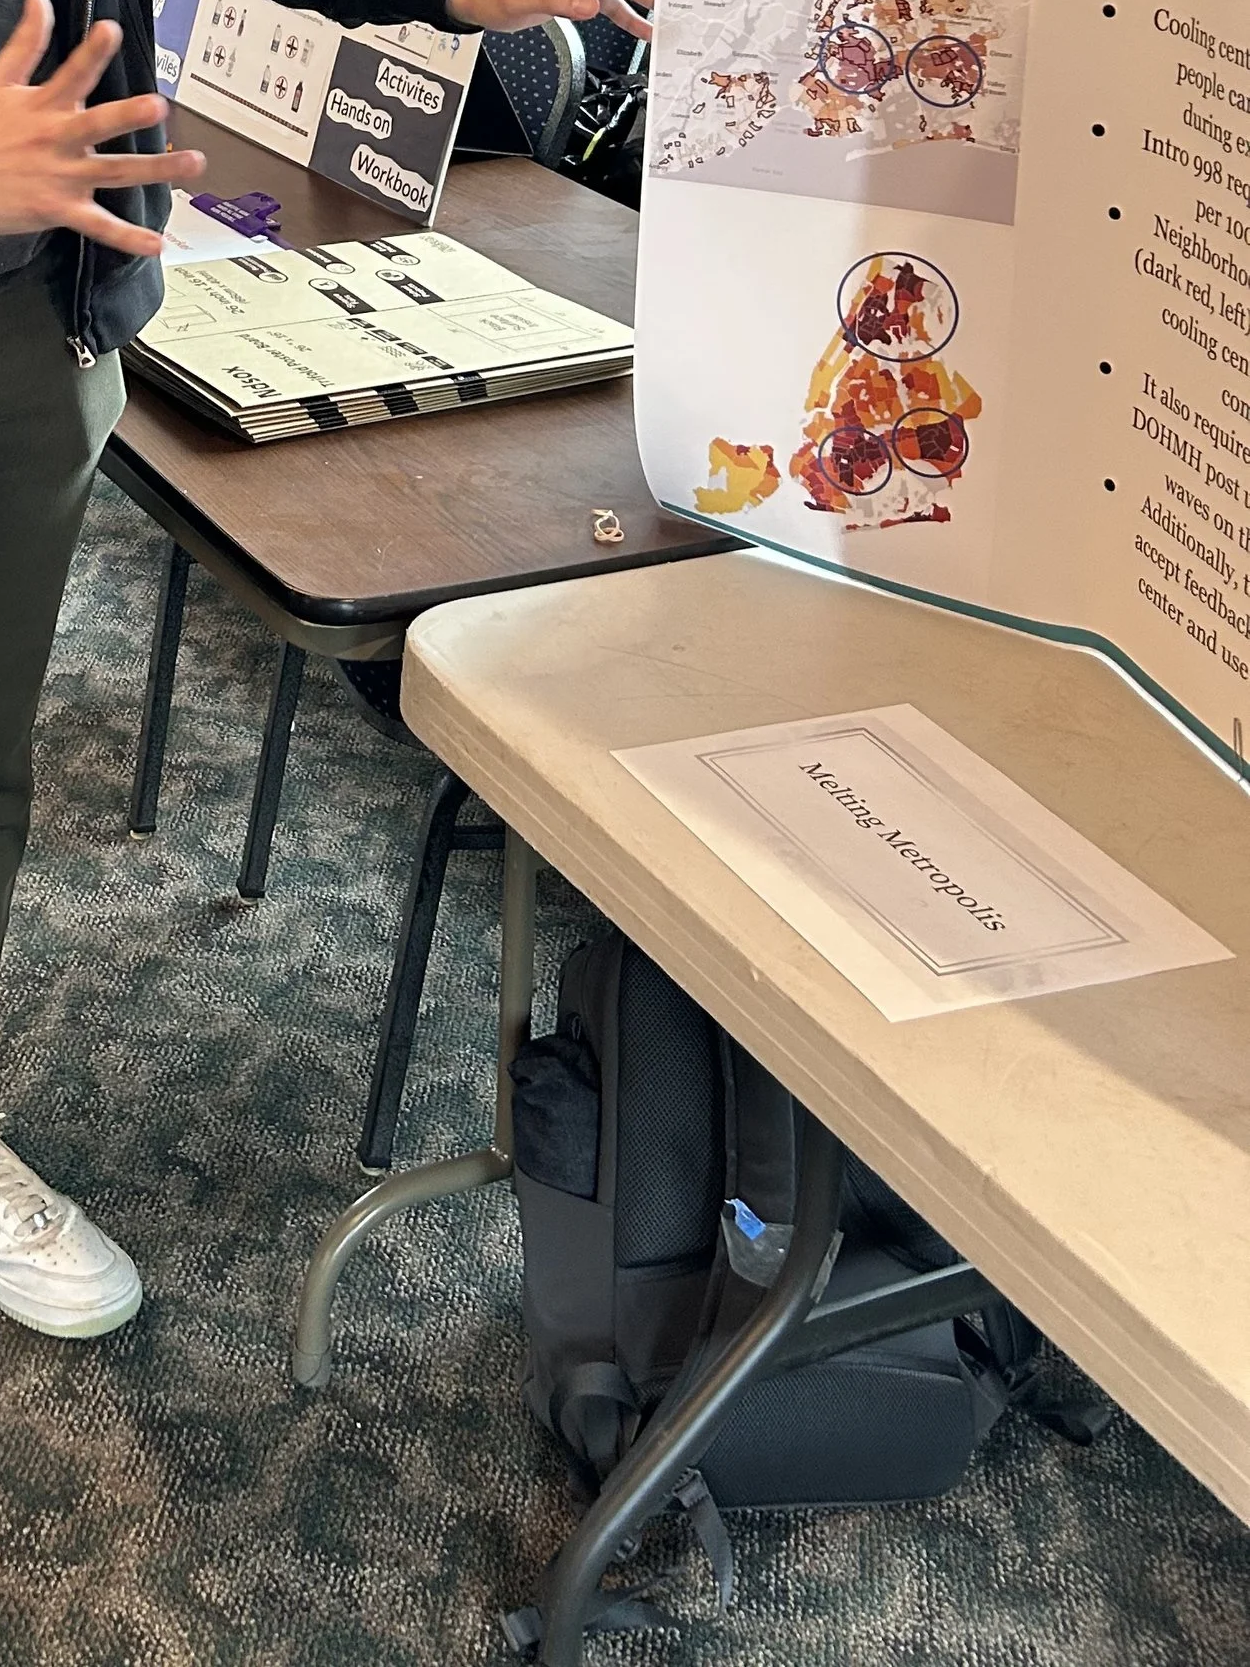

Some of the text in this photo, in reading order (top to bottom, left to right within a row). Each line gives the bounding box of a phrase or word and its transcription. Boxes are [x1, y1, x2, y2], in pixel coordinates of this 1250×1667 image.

[1154, 8, 1216, 59] Cooling
[378, 66, 440, 110] Activites
[1175, 62, 1225, 101] people
[331, 92, 391, 135] Hands on
[1183, 101, 1232, 154] during
[357, 151, 429, 209] Workbook
[1141, 128, 1189, 167] Intro
[1193, 155, 1223, 185] 998
[1195, 199, 1223, 227] per
[1153, 214, 1250, 289] Neighborho
[210, 291, 231, 306] inch
[1134, 248, 1182, 291] (dark
[1185, 279, 1215, 315] red,
[226, 305, 245, 314] 26
[1162, 308, 1219, 361] cooling
[221, 366, 282, 398] Ndsox
[235, 333, 335, 388] Trifold Poster Board
[1142, 372, 1156, 399] It
[1160, 387, 1190, 422] also
[1132, 406, 1203, 472] DOHMH
[1204, 462, 1240, 501] post
[1165, 474, 1211, 522] waves
[1214, 513, 1234, 540] on
[1135, 534, 1180, 583] accept
[1140, 495, 1239, 591] Additionally,
[1138, 577, 1250, 681] center and use
[798, 762, 1006, 932] Melting Metropolis
